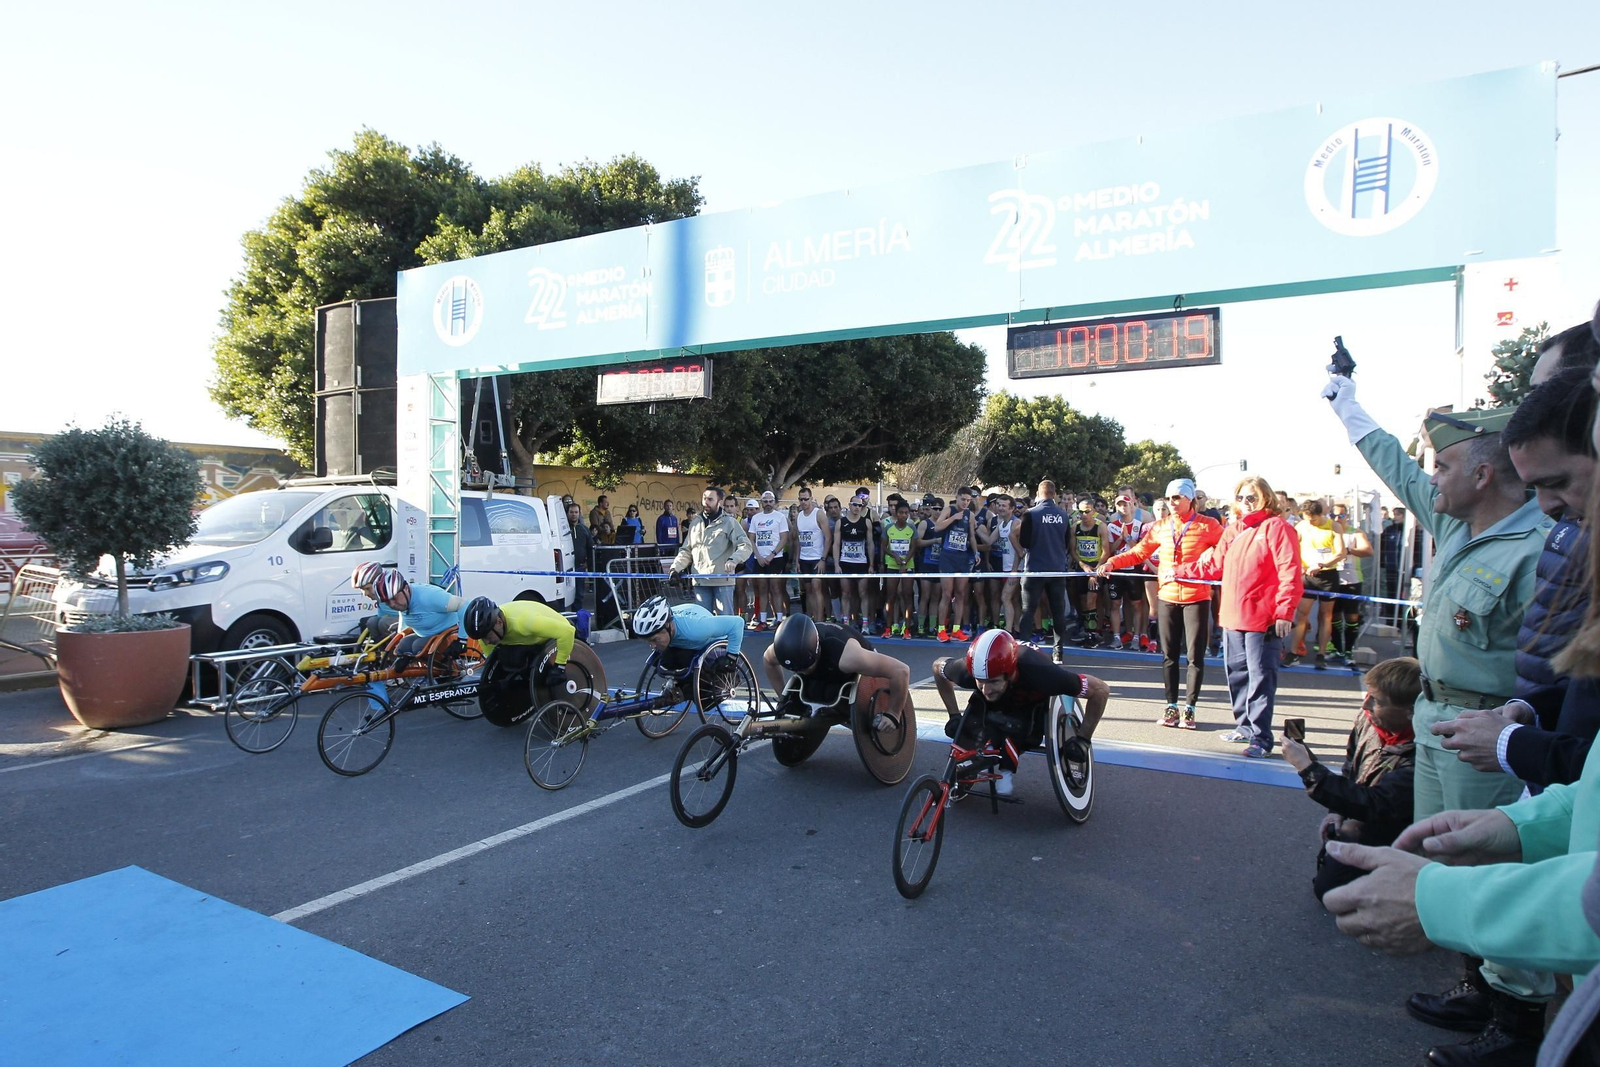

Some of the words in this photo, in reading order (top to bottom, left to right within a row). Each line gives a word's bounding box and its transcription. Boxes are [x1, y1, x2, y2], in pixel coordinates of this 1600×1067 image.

[1313, 137, 1343, 168] Medio
[1074, 181, 1160, 211] MEDIO
[1074, 197, 1210, 237] MARATÓN
[763, 217, 911, 272] ALMERÍA
[1074, 225, 1195, 262] ALMERÍA
[576, 266, 625, 287] MEDIO
[762, 268, 836, 295] CIUDAD
[576, 279, 653, 306] MARATÓN
[576, 300, 644, 325] ALMERÍA
[1056, 314, 1209, 367] 10:00:19
[1042, 513, 1063, 524] NEXA
[267, 555, 284, 566] 10
[331, 605, 356, 614] RENTA
[413, 695, 427, 705] MI
[429, 686, 478, 702] ESPERANZA
